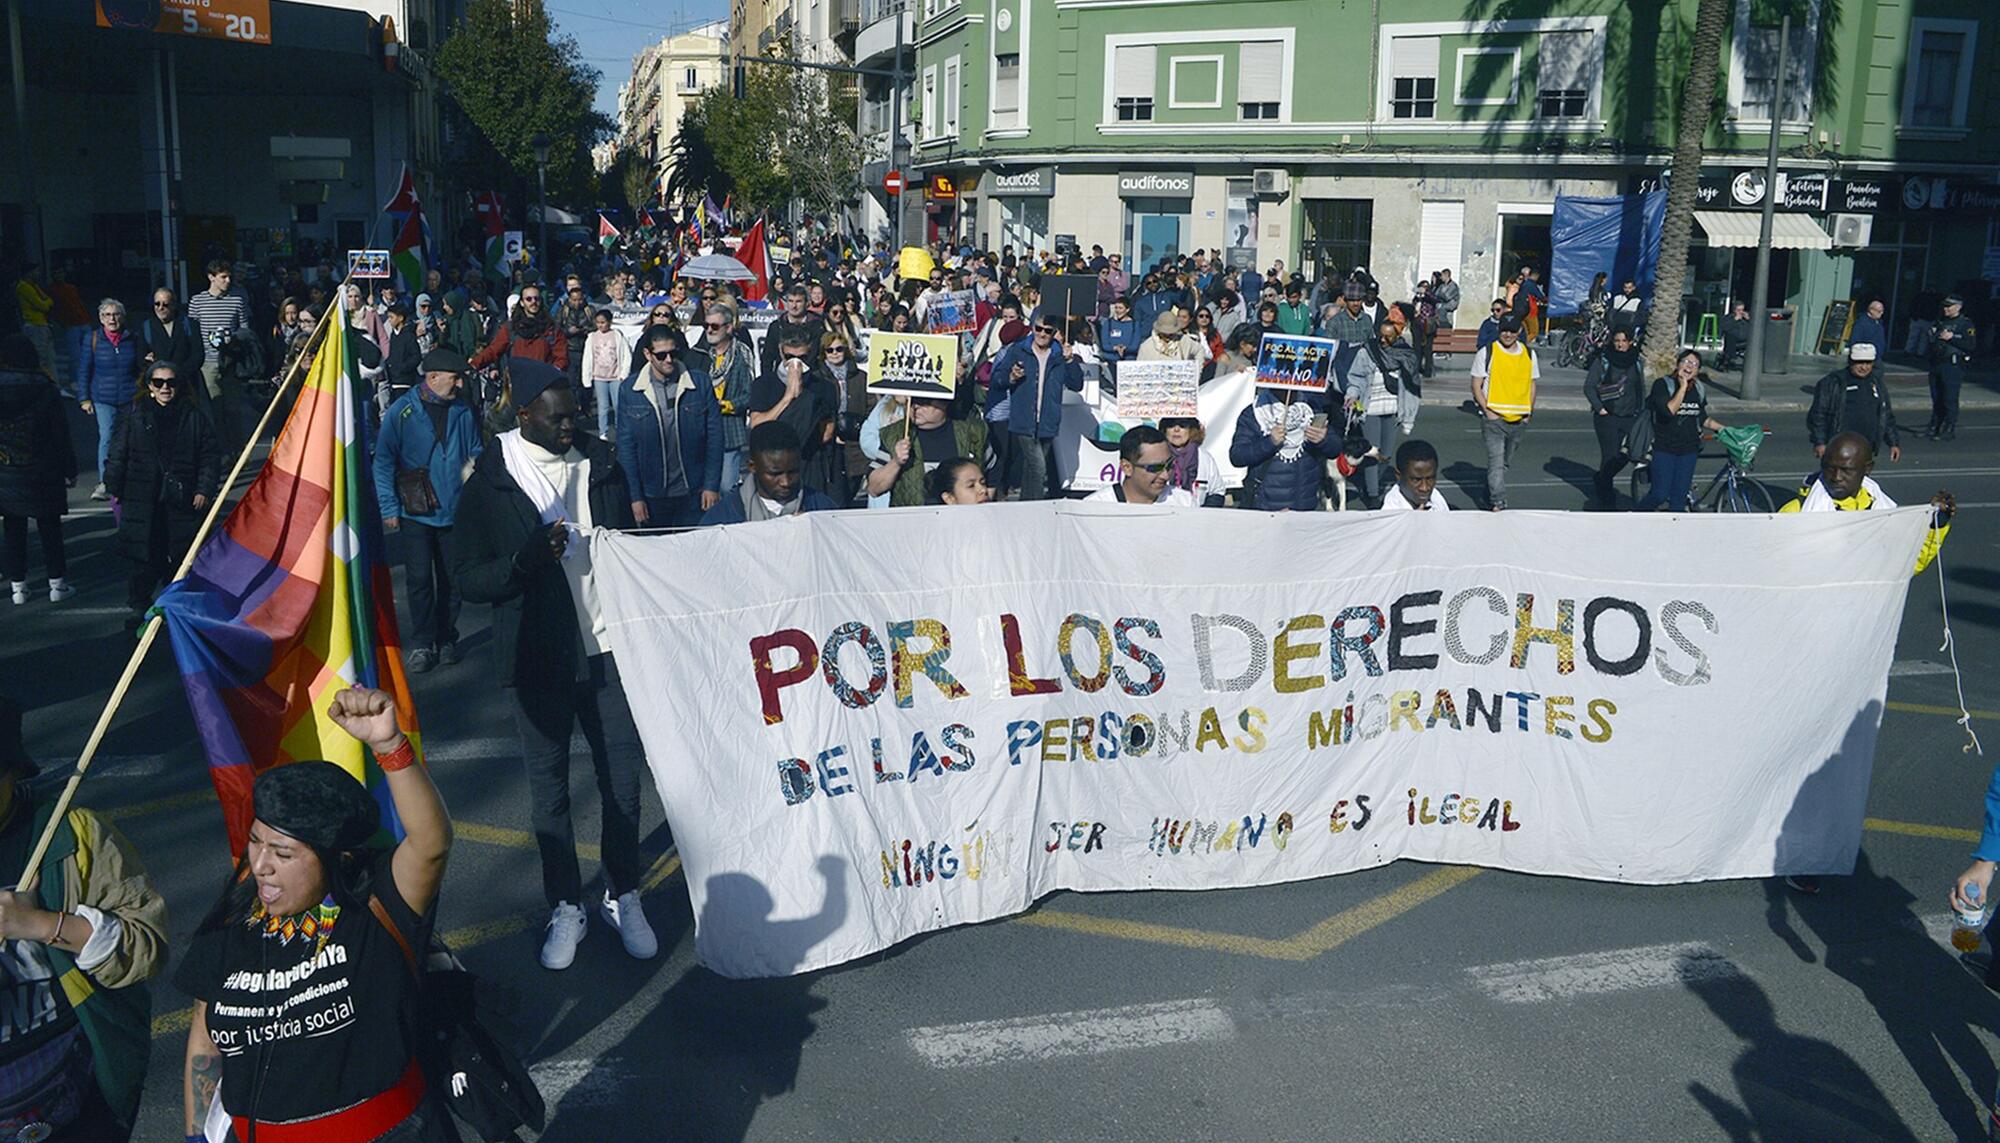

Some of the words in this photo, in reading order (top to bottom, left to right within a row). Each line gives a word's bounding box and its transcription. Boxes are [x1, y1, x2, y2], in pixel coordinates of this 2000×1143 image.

[183, 9, 198, 32] 5
[225, 14, 256, 40] 20
[1121, 175, 1189, 190] audífonos
[897, 339, 926, 358] NO
[1292, 367, 1312, 383] NO
[750, 618, 971, 725] POR
[999, 612, 1168, 699] LOS
[1188, 586, 1720, 694] DERECHOS
[776, 744, 854, 806] DE
[870, 722, 976, 784] LAS
[1005, 706, 1270, 767] PERSONAS
[1045, 820, 1108, 854] SER
[1148, 815, 1293, 858] HUMANO
[1329, 793, 1372, 834] ES
[289, 978, 349, 1006] condiciones
[304, 995, 355, 1032] social
